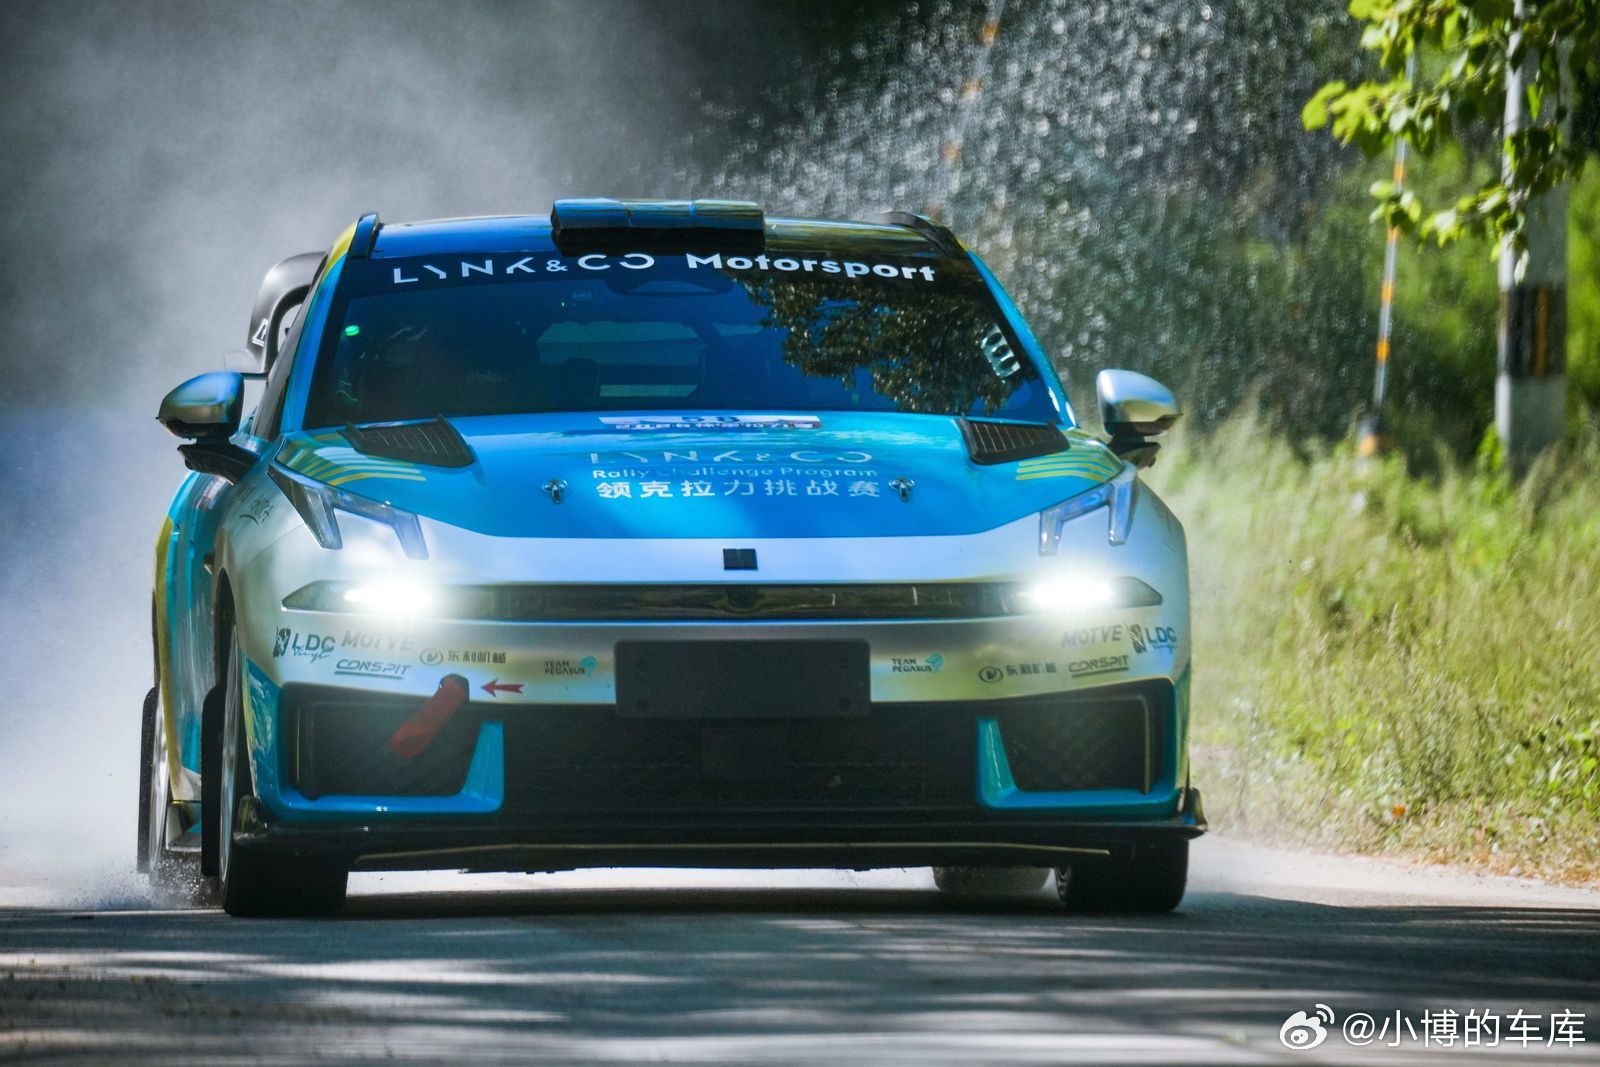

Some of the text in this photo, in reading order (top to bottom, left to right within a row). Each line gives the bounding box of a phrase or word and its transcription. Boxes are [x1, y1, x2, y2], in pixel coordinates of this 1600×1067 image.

[686, 252, 936, 282] Motorsport
[592, 468, 648, 479] Rally
[780, 466, 878, 478] Program
[596, 479, 880, 499] 领克拉力挑战赛
[292, 632, 336, 652] LDC
[336, 659, 411, 675] CONSPIT
[544, 667, 585, 675] PEGASUS
[892, 665, 933, 673] PEGASUS
[1068, 655, 1129, 672] CONSPIT
